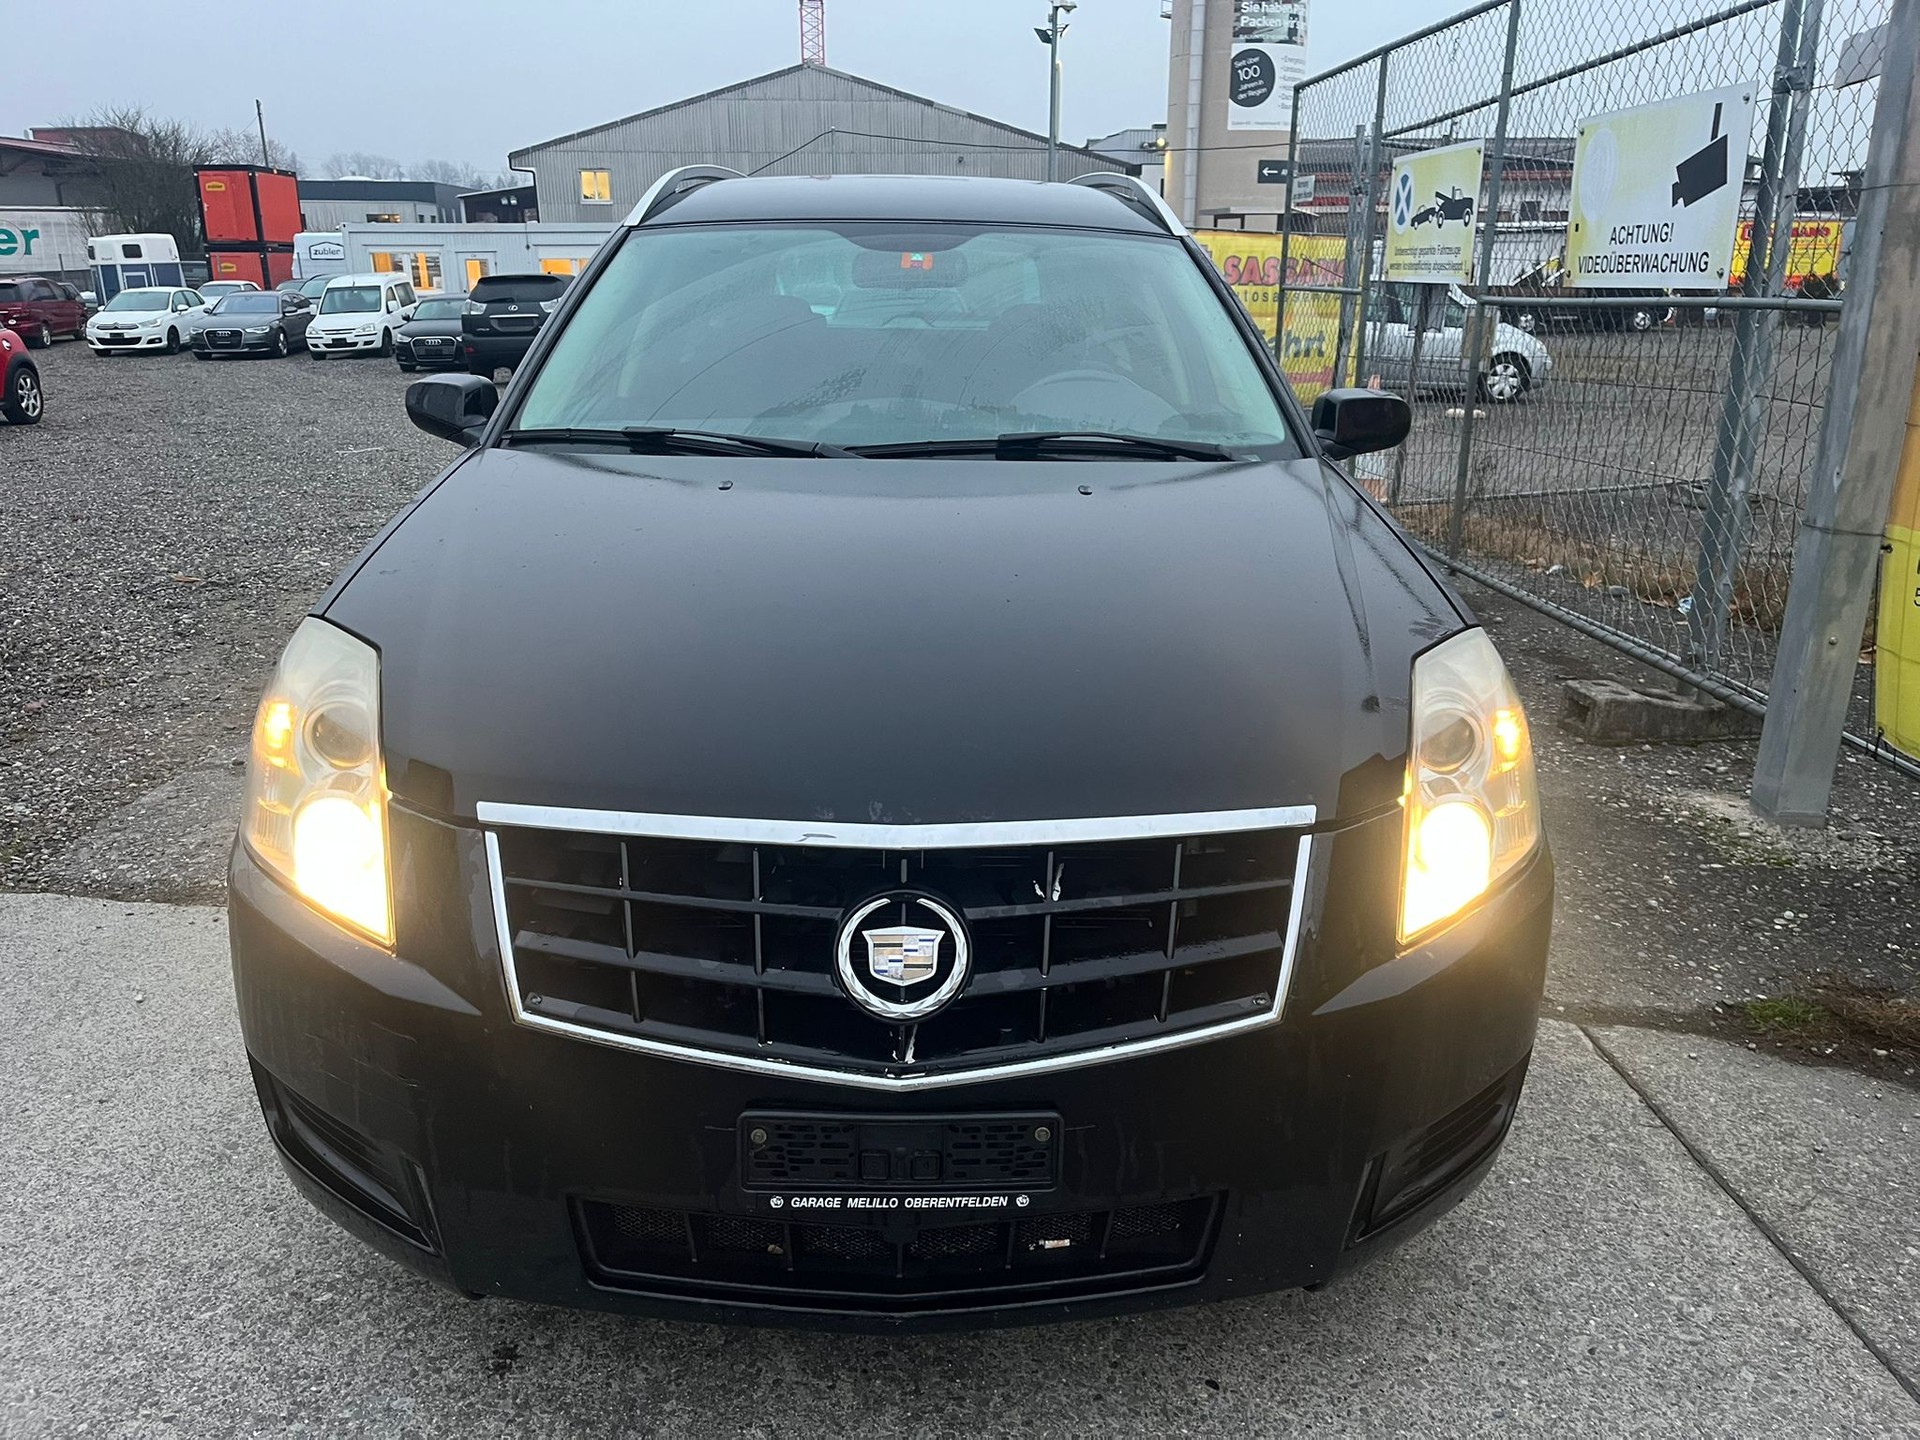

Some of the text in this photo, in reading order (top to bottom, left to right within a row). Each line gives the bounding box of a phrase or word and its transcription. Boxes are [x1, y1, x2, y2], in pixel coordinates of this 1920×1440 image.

[1240, 1, 1260, 13] Sie
[1240, 15, 1282, 28] Packen
[1237, 65, 1261, 81] 100
[1609, 222, 1674, 245] ACHTUNG!
[313, 248, 341, 256] zubler
[1578, 250, 1710, 273] VIDEOÜBERWACHUNG
[790, 1195, 1009, 1209] GARAGE MELILLO OBERENTFELDEN
